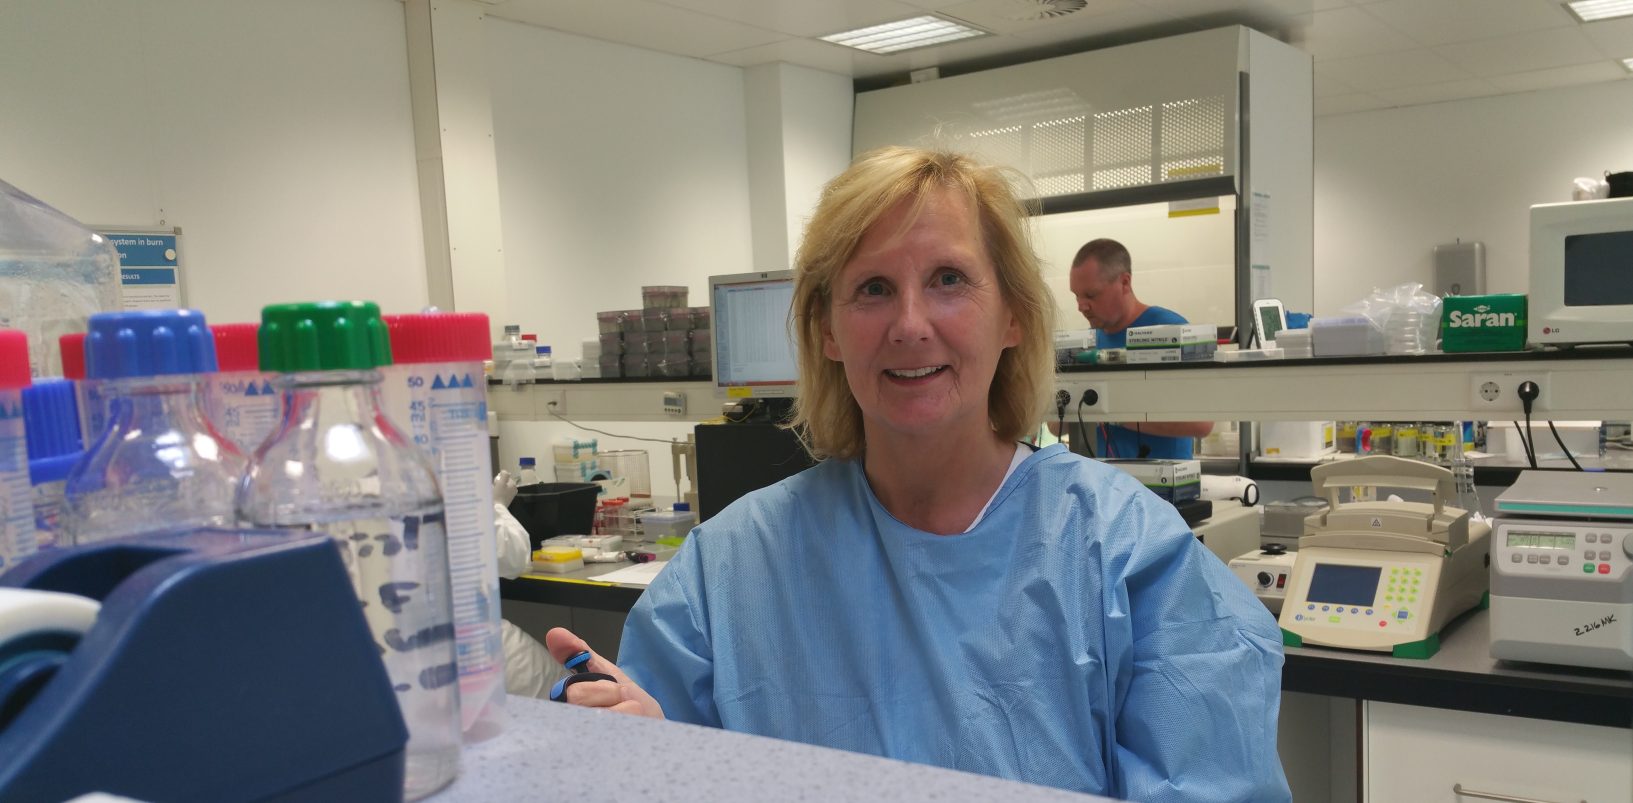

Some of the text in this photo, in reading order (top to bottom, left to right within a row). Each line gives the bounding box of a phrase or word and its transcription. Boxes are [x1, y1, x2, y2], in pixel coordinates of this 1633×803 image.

[138, 238, 145, 246] in
[146, 238, 163, 246] burn
[1449, 310, 1515, 328] Saran
[407, 375, 424, 388] 50
[408, 400, 426, 412] 45
